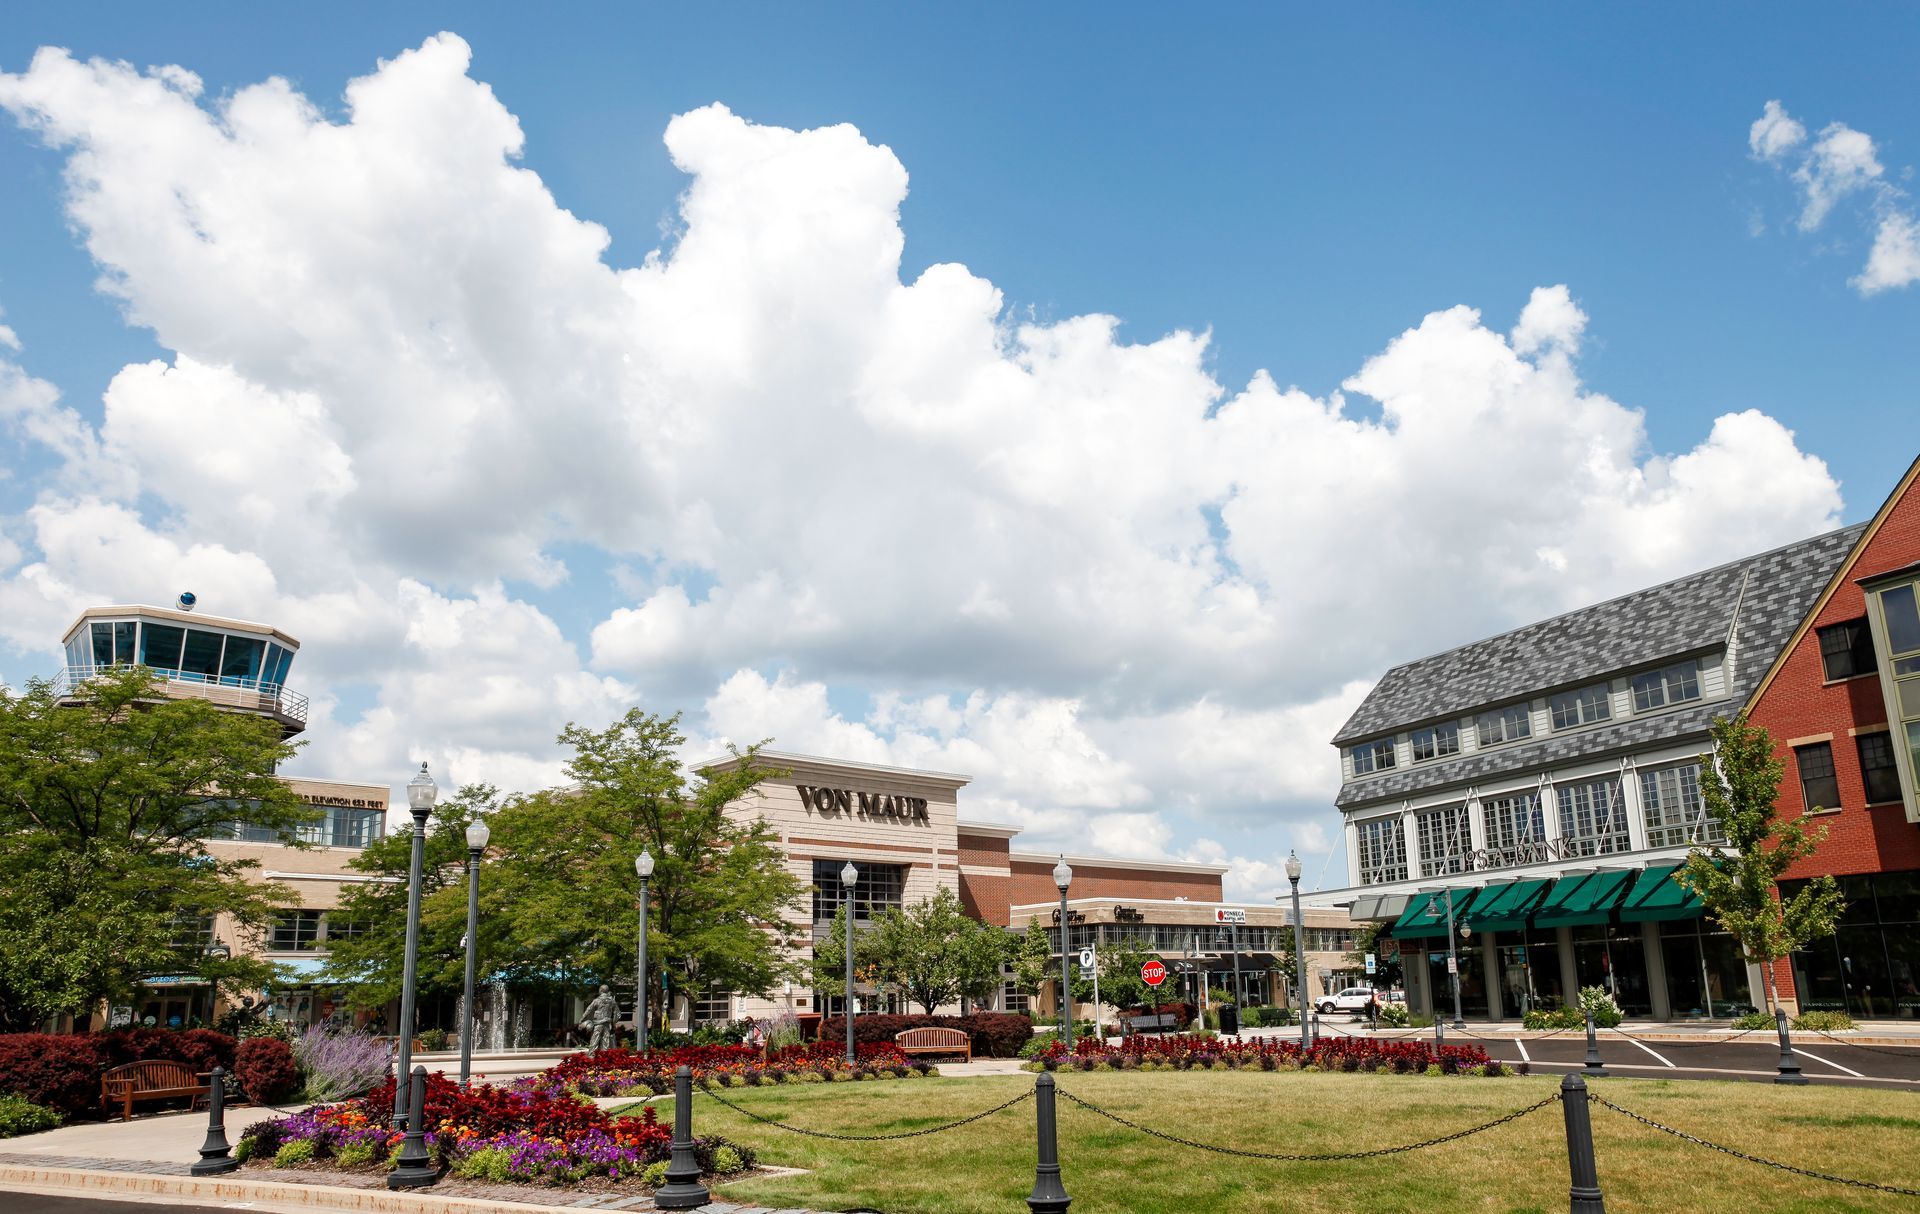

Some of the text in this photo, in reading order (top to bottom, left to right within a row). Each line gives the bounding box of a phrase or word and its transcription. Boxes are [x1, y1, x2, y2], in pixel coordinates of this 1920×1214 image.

[312, 795, 350, 806] ELEVATION
[367, 800, 383, 808] FEET
[796, 785, 930, 820] VON MAUR
[1514, 836, 1578, 865] BANK
[1084, 953, 1090, 964] P
[1143, 967, 1164, 979] STOP
